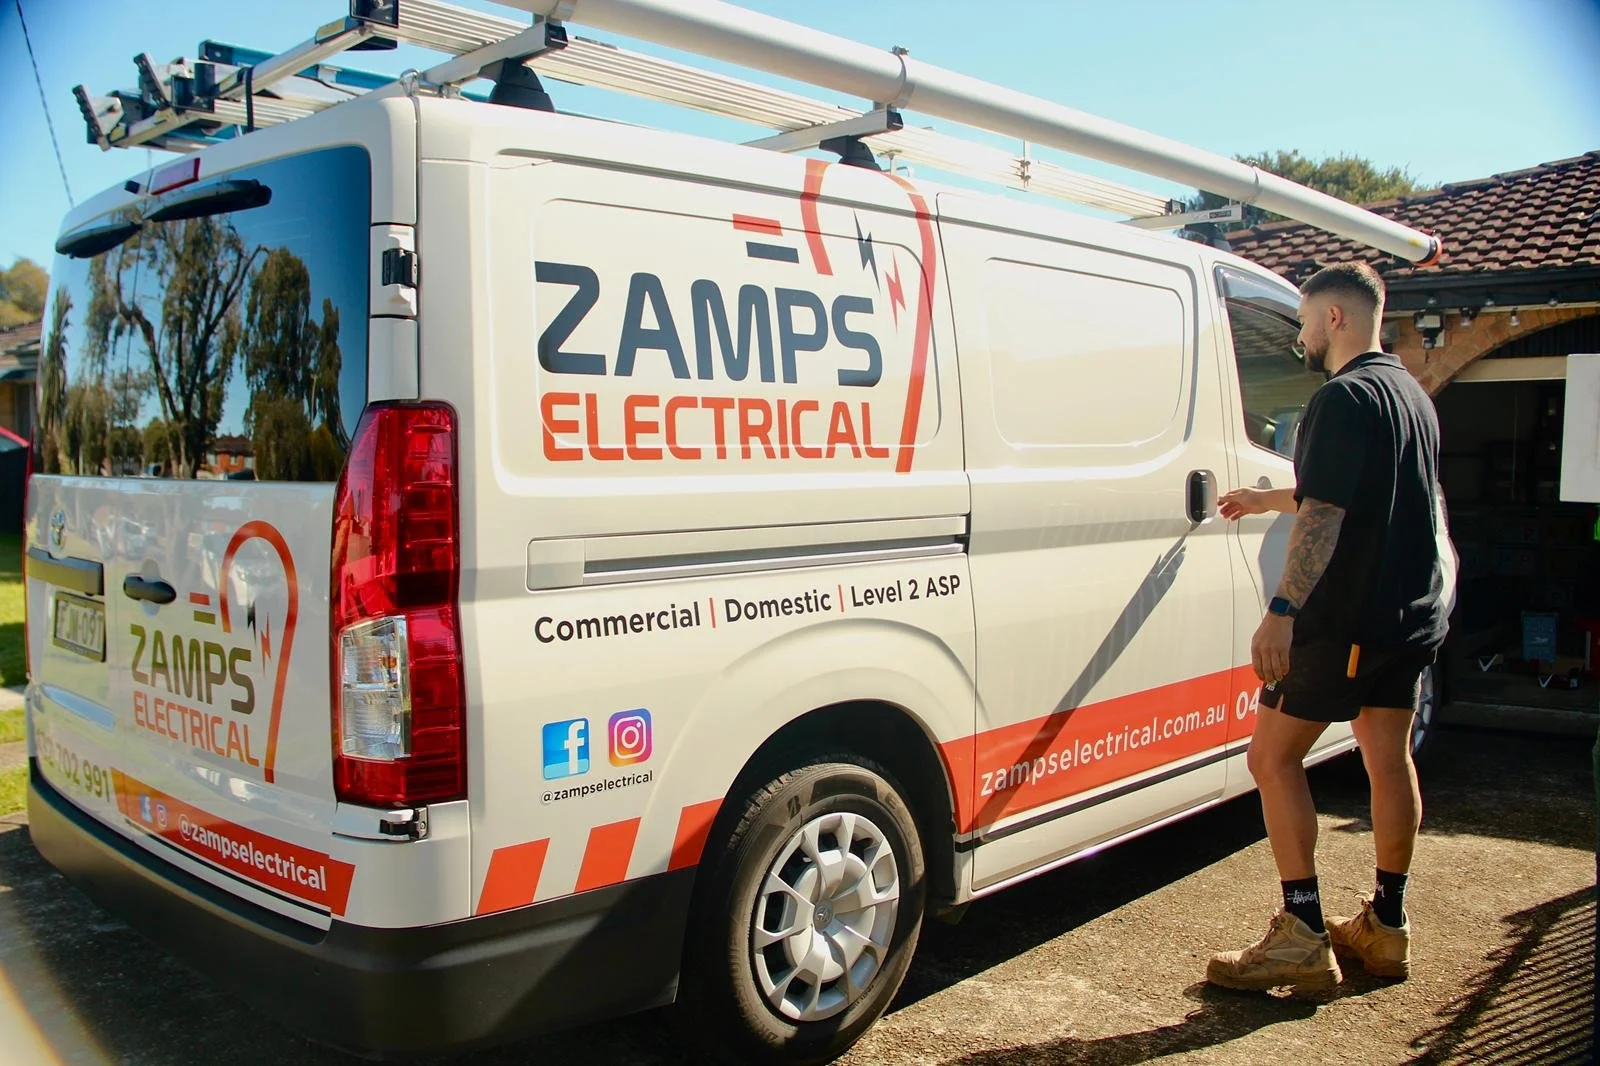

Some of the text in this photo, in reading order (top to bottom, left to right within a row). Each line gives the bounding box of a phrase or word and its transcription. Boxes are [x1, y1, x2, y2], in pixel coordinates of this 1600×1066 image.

[534, 260, 883, 387] ZAMPS
[540, 391, 890, 462] ELECTRICAL
[534, 574, 962, 644] Commercial Domestic Level 2 ASP
[130, 624, 256, 716] ZAMPS
[133, 690, 260, 767] ELECTRICAL
[980, 702, 1226, 796] zampselectrical.com.au
[83, 759, 110, 802] 991
[540, 770, 654, 805] @zampselectrical
[177, 813, 327, 892] @zampselectrical
